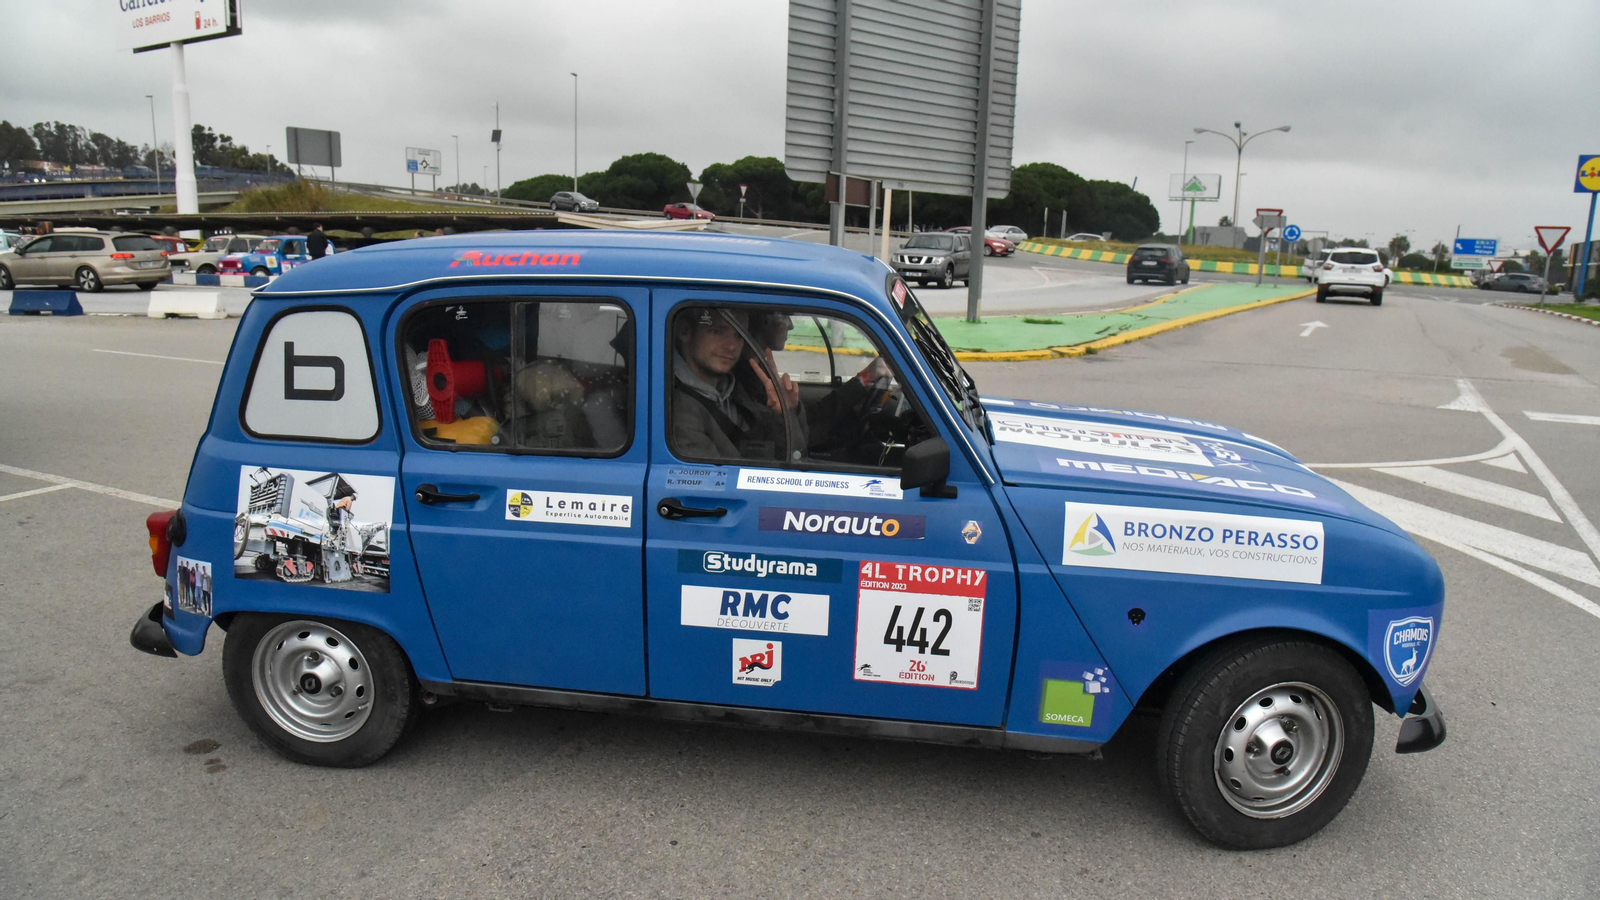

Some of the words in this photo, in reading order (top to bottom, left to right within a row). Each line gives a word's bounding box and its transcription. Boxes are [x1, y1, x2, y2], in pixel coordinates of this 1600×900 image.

[132, 18, 144, 29] LOS
[145, 12, 171, 26] BARRIOS
[203, 19, 211, 28] 24
[450, 251, 581, 267] Auchan
[284, 341, 345, 401] b
[998, 426, 1196, 454] MODULES
[747, 475, 775, 485] RENNES
[776, 477, 803, 487] SCHOOL
[804, 479, 814, 487] OF
[815, 480, 850, 489] BUSINESS
[546, 496, 630, 513] Lemaire
[545, 511, 581, 519] Expertise
[585, 513, 629, 521] Automobile
[782, 511, 900, 537] Norauto
[1123, 521, 1214, 542] BRONZO
[1222, 528, 1319, 551] PERASSO
[1122, 542, 1144, 552] NOS
[1146, 543, 1205, 557] MATÉRIAUX,
[1209, 548, 1230, 559] VOS
[1232, 550, 1318, 566] CONSTRUCTIONS
[705, 552, 818, 578] Studyrama
[861, 562, 887, 579] 4L
[895, 564, 986, 586] TROPHY
[860, 579, 890, 589] ÉDITION
[891, 582, 907, 590] 2023
[719, 590, 792, 620] RMC
[716, 617, 789, 631] DÉCOUVERTE
[883, 605, 953, 656] 442
[1393, 628, 1429, 645] CHAMOIS
[899, 670, 935, 682] ÉDITION
[1045, 712, 1084, 723] SOMECA
